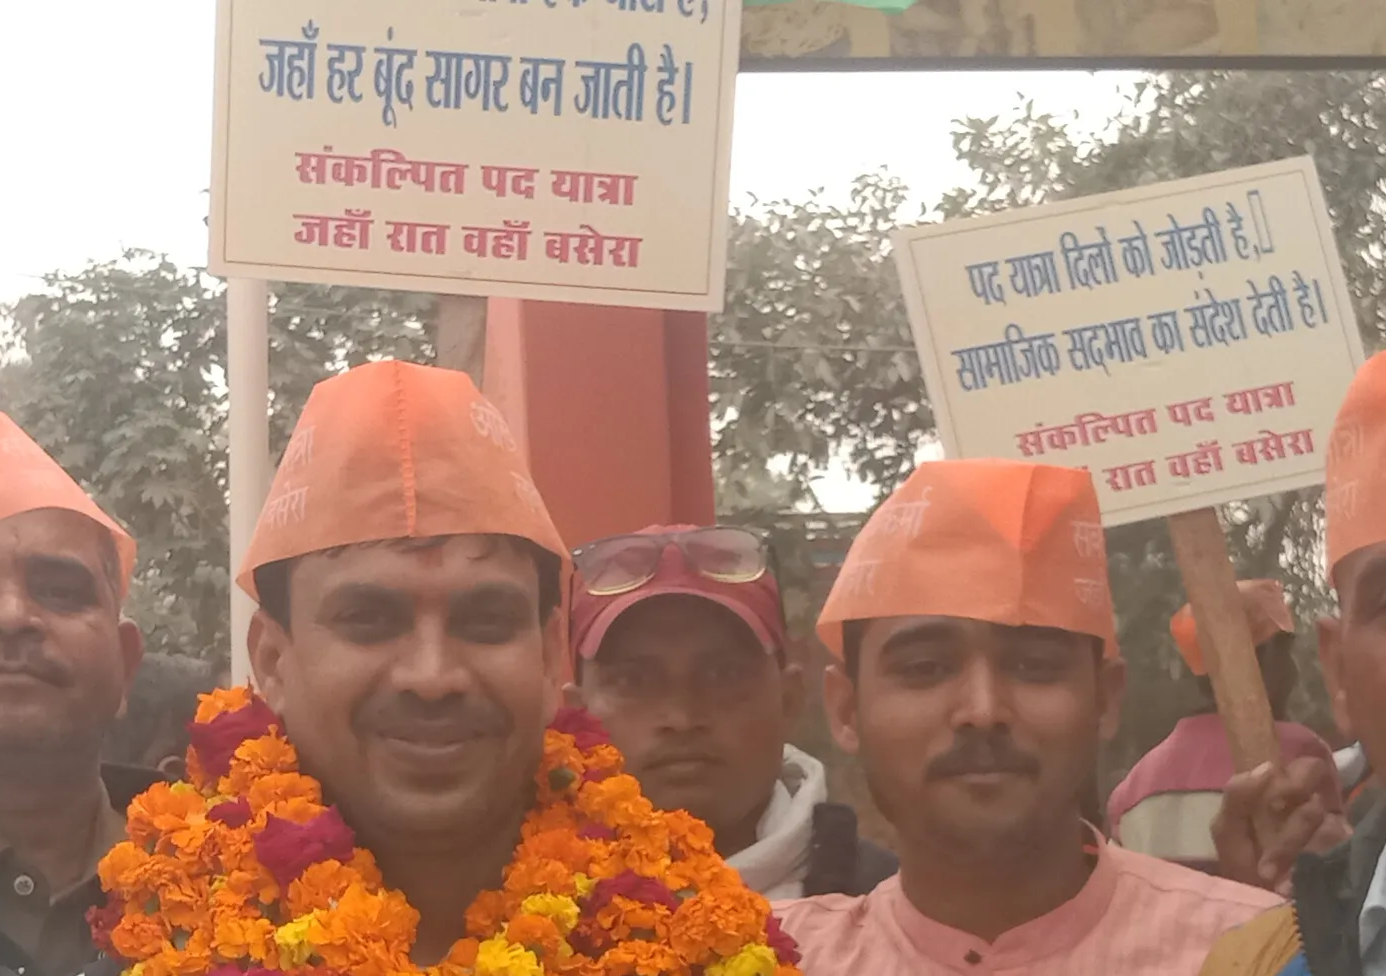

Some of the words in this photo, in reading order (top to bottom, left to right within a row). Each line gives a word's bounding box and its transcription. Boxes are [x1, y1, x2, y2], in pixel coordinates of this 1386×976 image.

[259, 19, 319, 100] जहाँ
[327, 43, 366, 103] हर
[373, 26, 417, 128] बूंद
[425, 50, 511, 112] सागर
[519, 56, 565, 116] बन
[574, 42, 648, 121] जाती
[295, 145, 469, 194] संकल्पित
[481, 165, 540, 198] पद
[550, 170, 639, 206] यात्रा
[292, 208, 375, 250] जहाँ
[385, 220, 451, 255] रात
[462, 220, 532, 261] वहाँ
[544, 224, 643, 268] बसेरा
[965, 261, 1007, 306] पद
[1005, 251, 1061, 298] यात्रा
[1117, 220, 1155, 278] को
[1154, 207, 1227, 280] जोड़ती
[951, 323, 1060, 391] सामाजिक
[1147, 311, 1185, 354] का
[1183, 288, 1248, 347] संदेश
[1246, 275, 1294, 338] देती
[1015, 410, 1158, 456] संकल्पित
[1166, 397, 1215, 426] पद
[1223, 381, 1296, 414] यात्रा
[1103, 460, 1158, 491] रात
[1232, 429, 1314, 464] बसेरा
